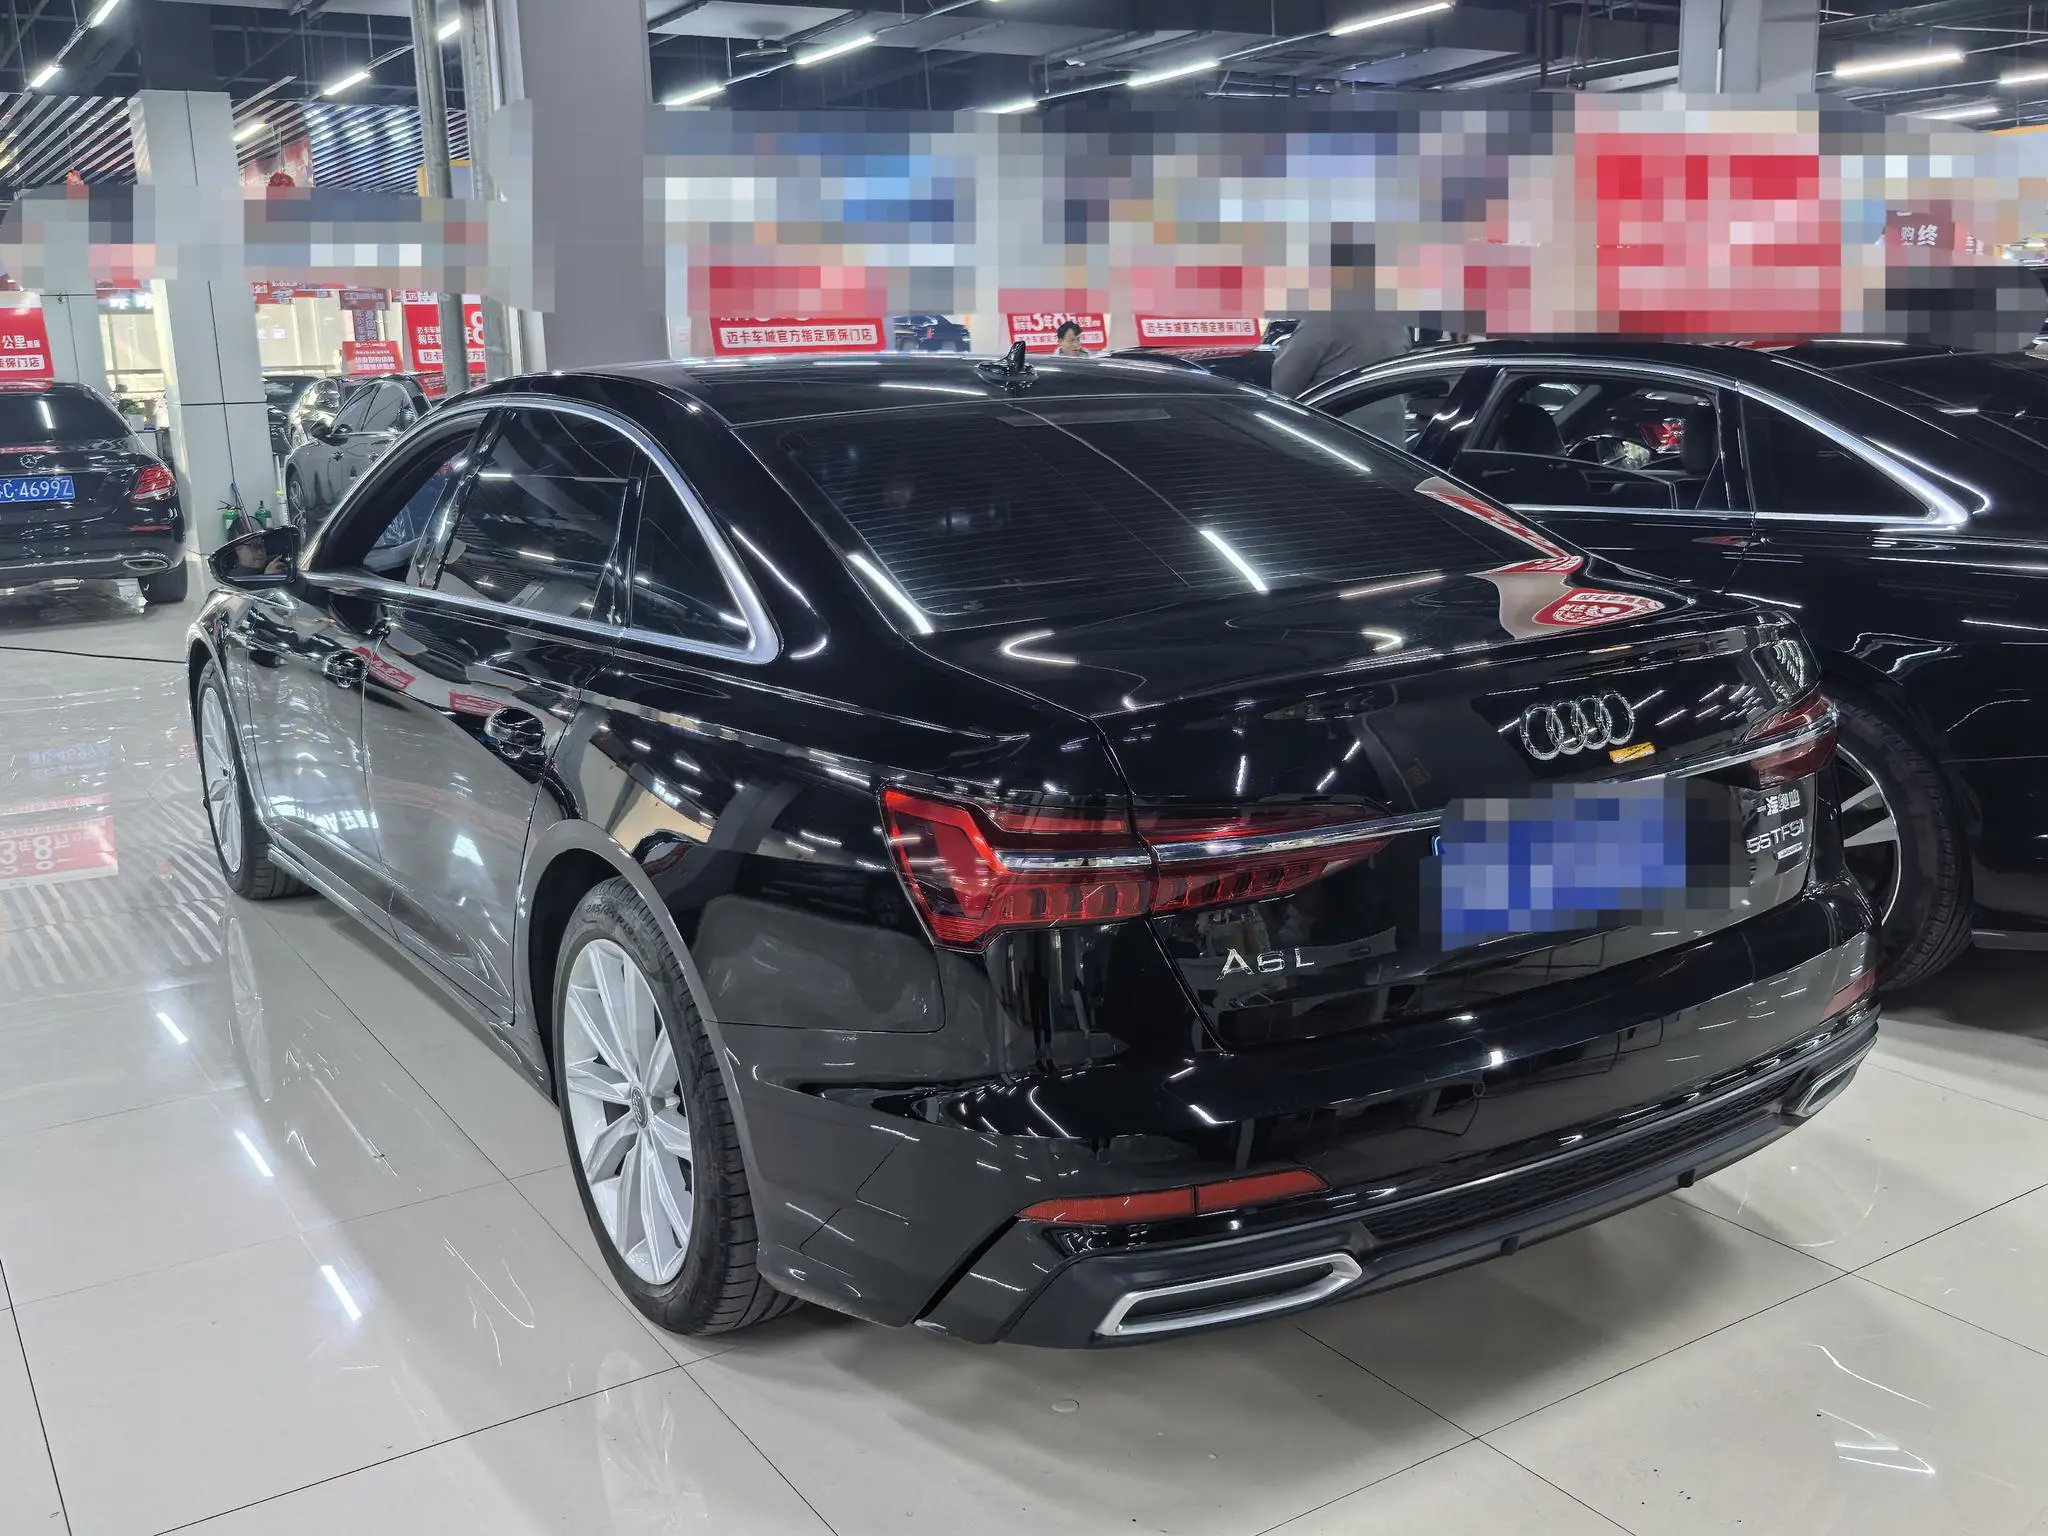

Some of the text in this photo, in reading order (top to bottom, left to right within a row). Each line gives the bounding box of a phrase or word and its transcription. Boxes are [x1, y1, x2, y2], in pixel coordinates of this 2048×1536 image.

[726, 328, 873, 344] 迈卡车城官方指定质保门店
